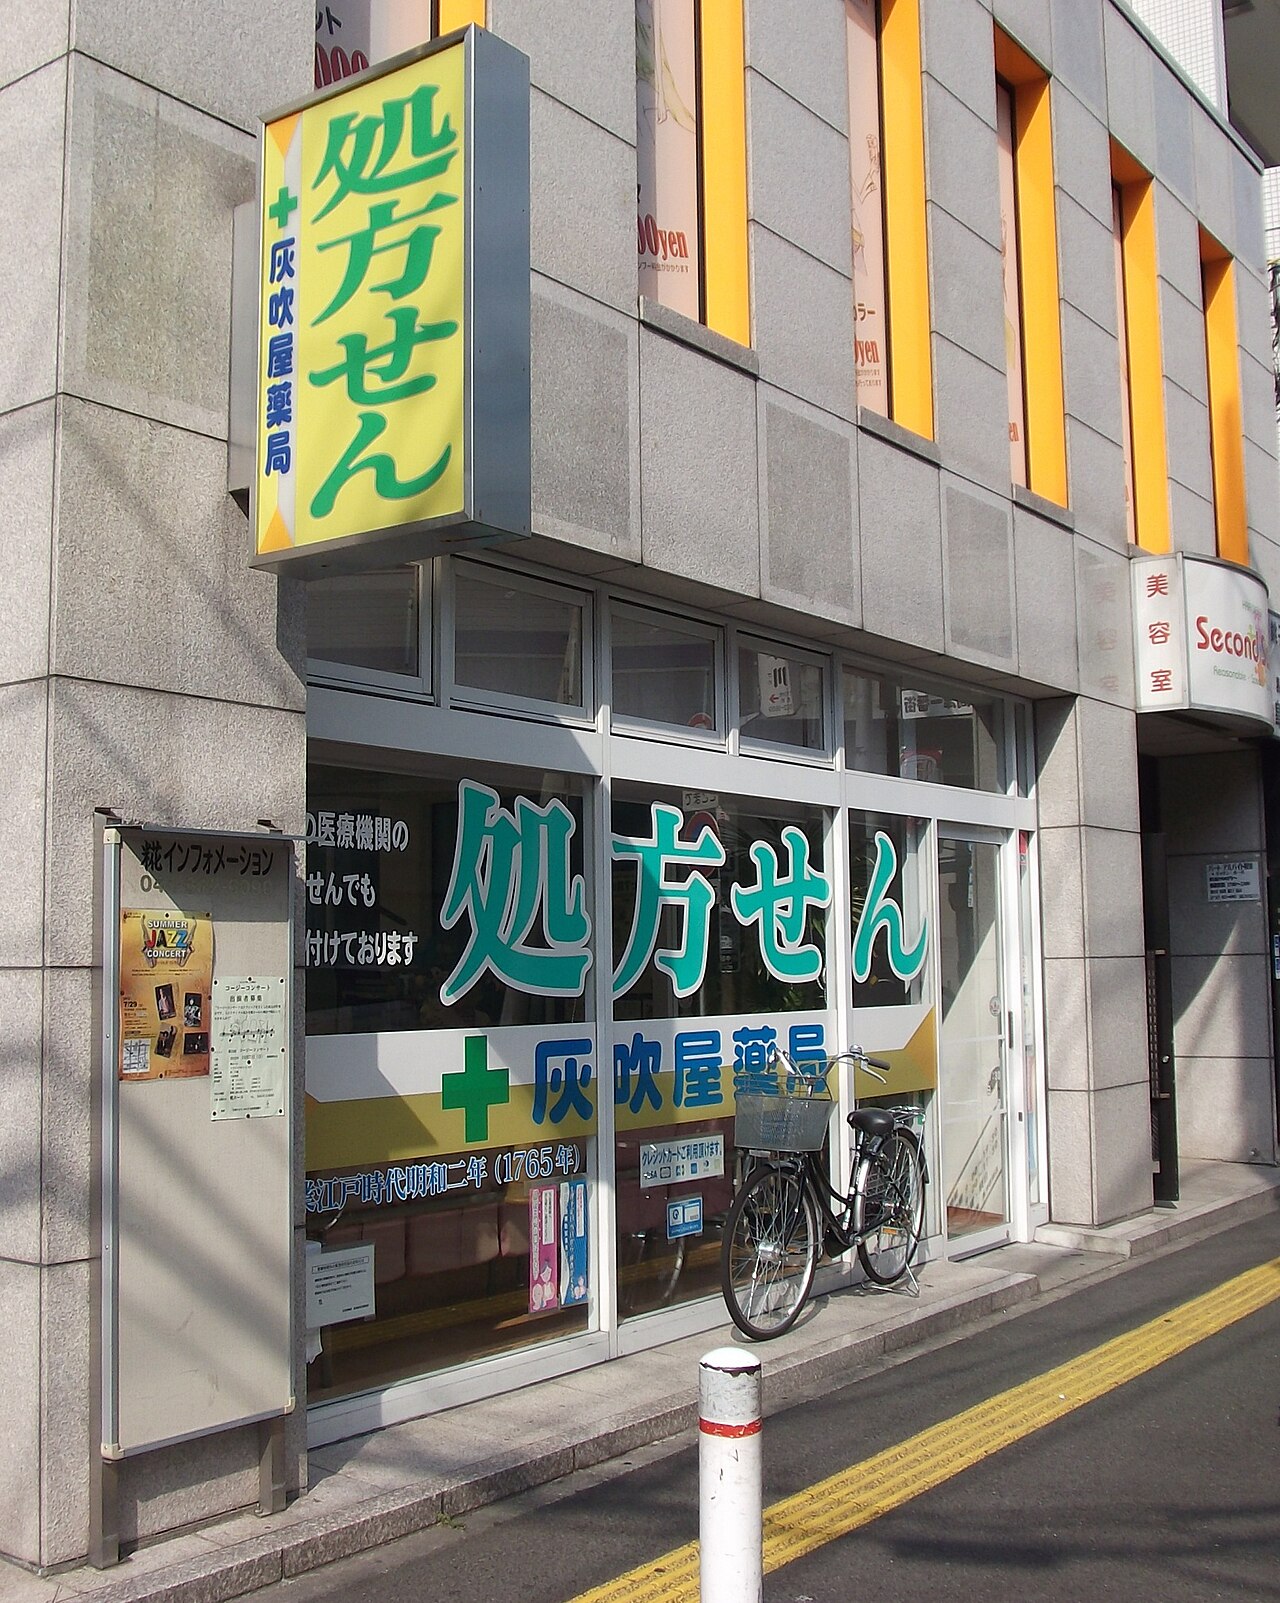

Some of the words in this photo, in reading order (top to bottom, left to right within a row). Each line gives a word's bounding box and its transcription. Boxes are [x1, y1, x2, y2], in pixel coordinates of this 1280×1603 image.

[309, 83, 460, 519] 処方せん
[264, 237, 298, 477] 灰吹屋薬局
[1146, 573, 1174, 693] 美容室
[147, 919, 188, 929] SUMMER
[306, 870, 377, 908] せんでも
[439, 777, 929, 1007] 処方せん
[146, 929, 189, 949] JAZZ
[147, 948, 187, 959] CONCERT
[305, 928, 419, 967] 付けております
[532, 1023, 829, 1127] 灰吹屋薬局
